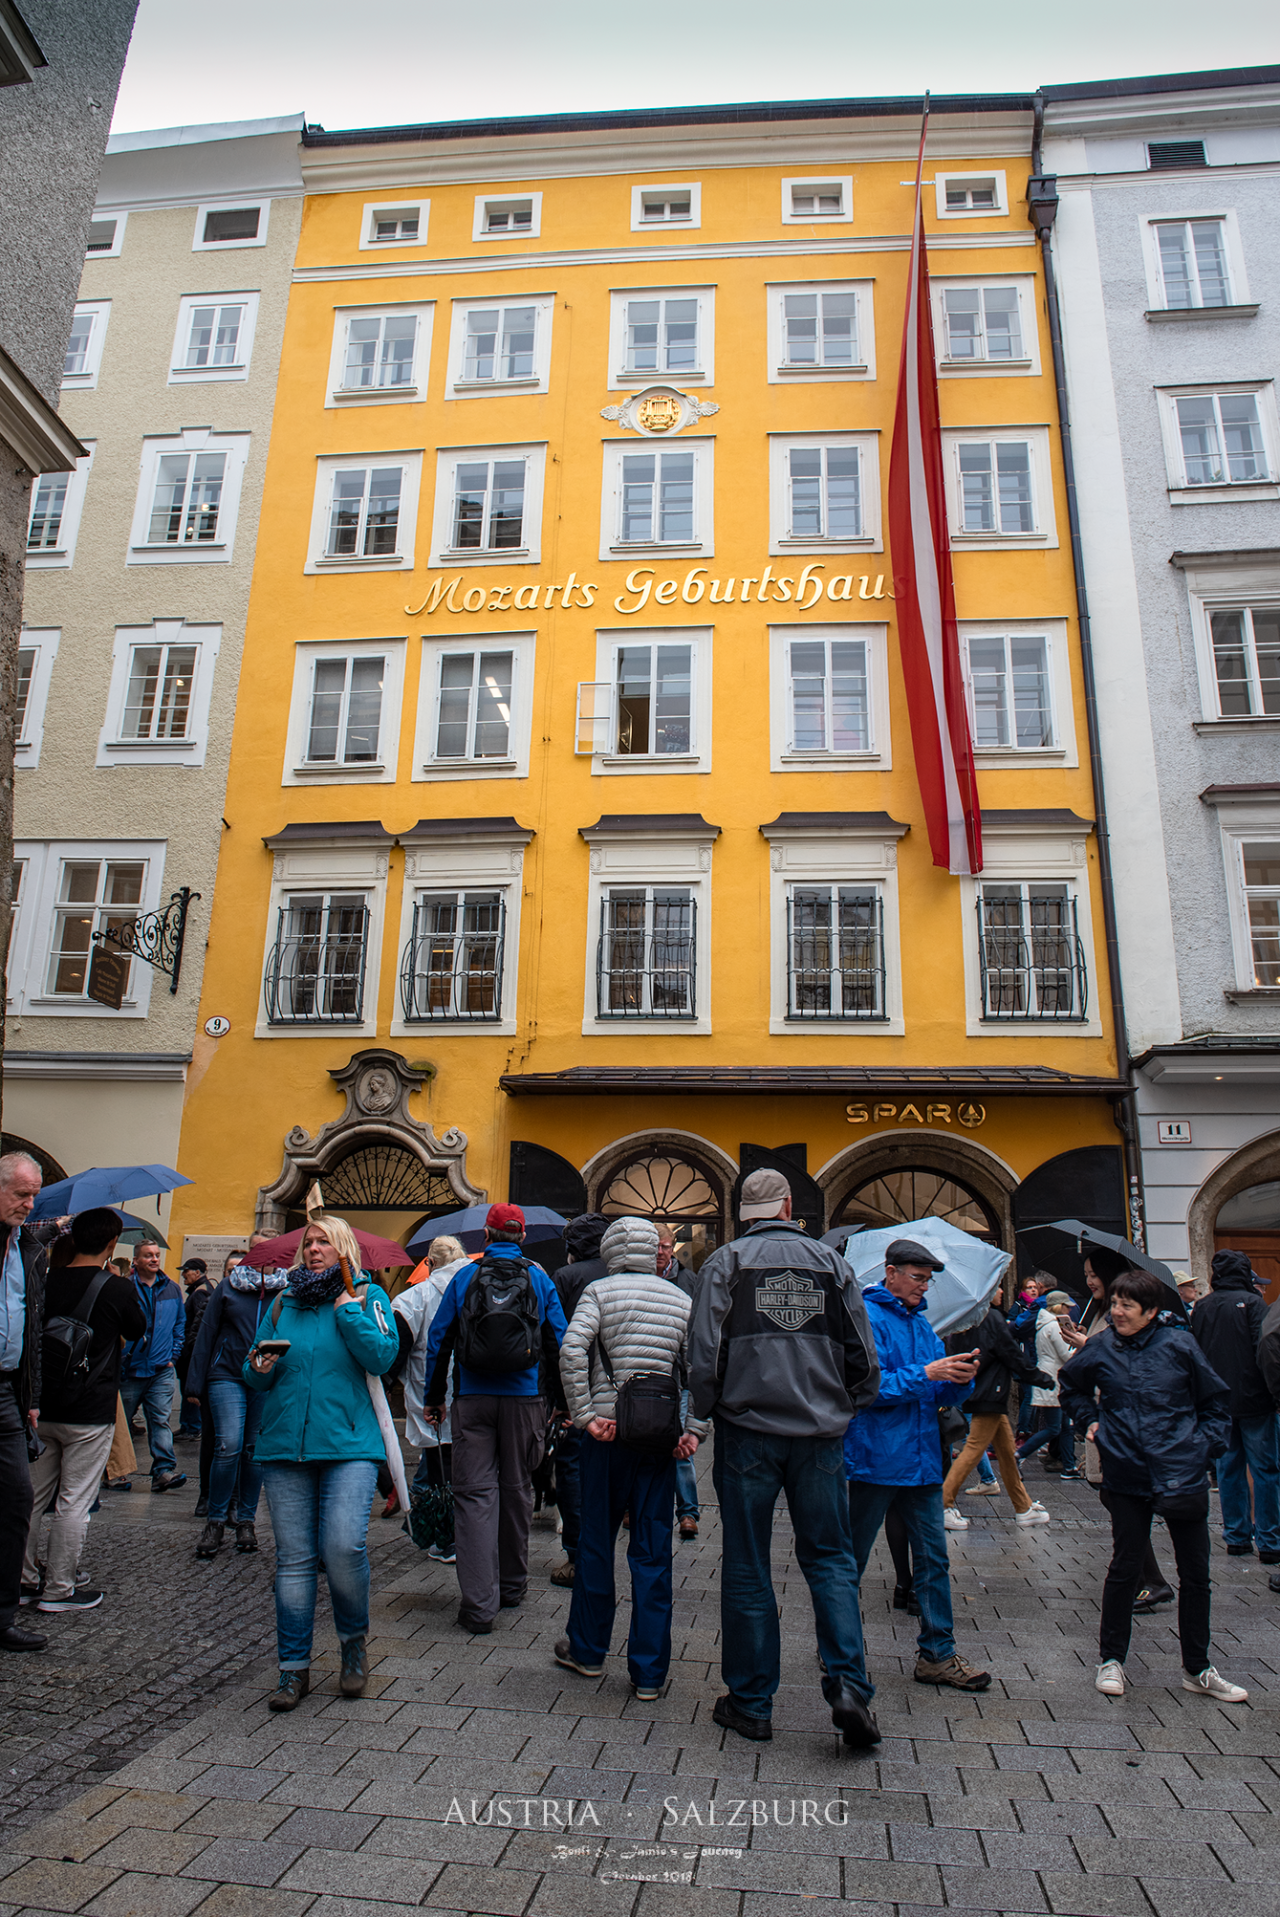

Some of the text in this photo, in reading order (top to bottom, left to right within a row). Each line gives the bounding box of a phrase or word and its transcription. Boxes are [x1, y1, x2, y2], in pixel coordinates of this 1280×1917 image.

[403, 571, 599, 616] Mozarts
[213, 1018, 221, 1030] 9
[845, 1102, 952, 1124] SPAR
[1167, 1124, 1182, 1135] 11
[774, 1278, 805, 1292] MOTOR
[760, 1294, 819, 1307] HARLEY-DAVIDSON
[774, 1310, 804, 1324] CYCLES
